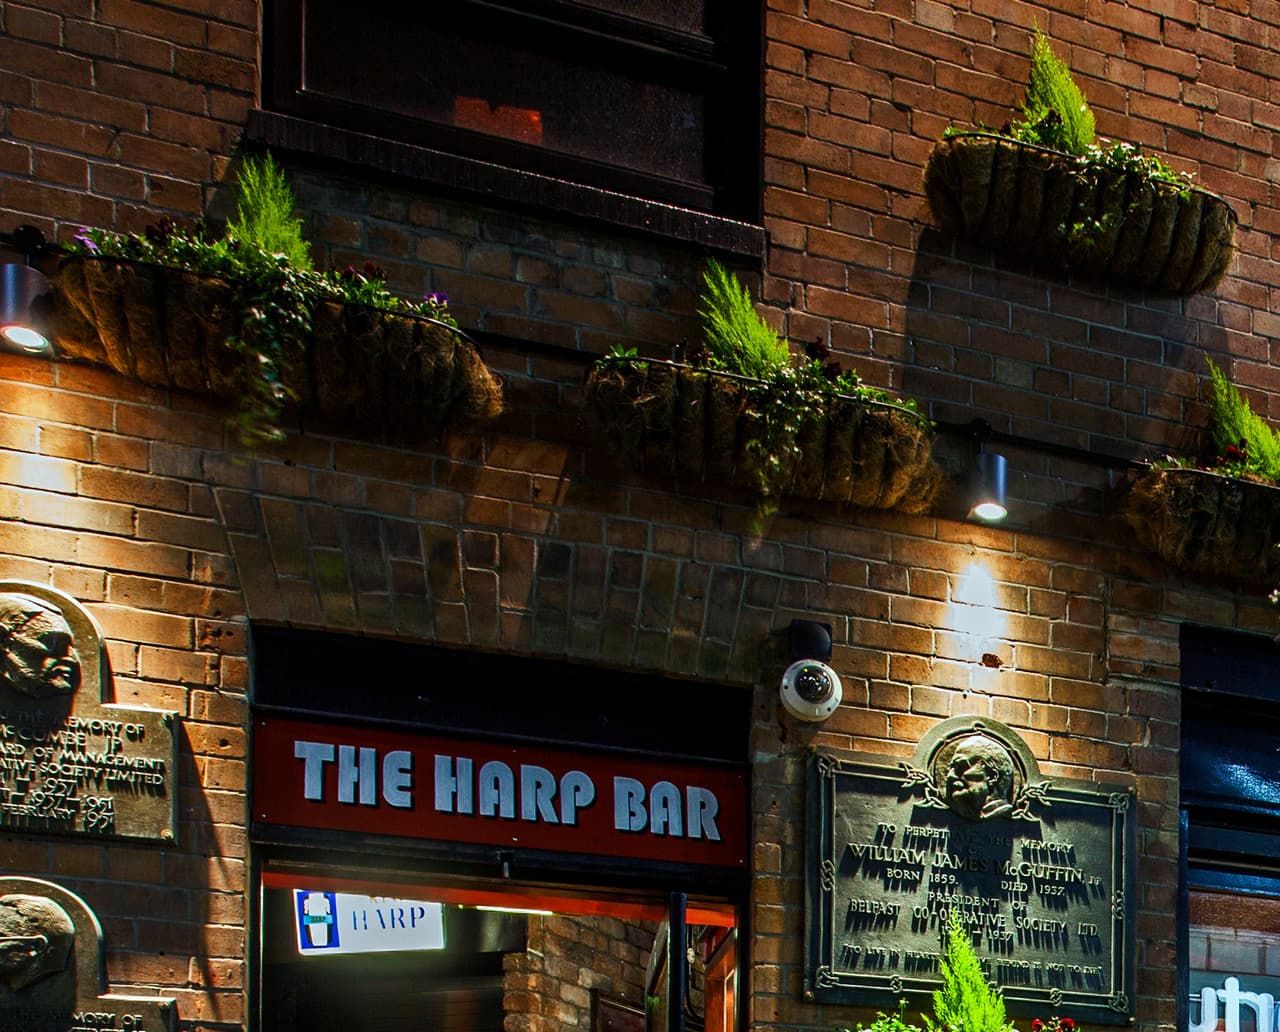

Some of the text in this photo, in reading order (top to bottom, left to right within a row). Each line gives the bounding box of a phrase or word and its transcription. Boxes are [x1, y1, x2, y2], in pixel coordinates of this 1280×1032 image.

[57, 715, 122, 732] EMORY
[60, 750, 165, 770] MANAGEMENT
[40, 762, 103, 778] SOCIETY
[105, 768, 164, 785] LIMITED
[294, 740, 721, 842] THE HARP BAR
[878, 822, 898, 833] TO
[1020, 838, 1075, 853] MEMORY
[848, 842, 927, 866] WILLIAM
[886, 868, 921, 881] BORN
[1001, 880, 1028, 892] DIED
[929, 892, 1027, 911] PRESIDENT OF
[352, 906, 426, 931] HARP
[850, 899, 901, 916] BELFAST
[1016, 916, 1068, 934] SOCIETY
